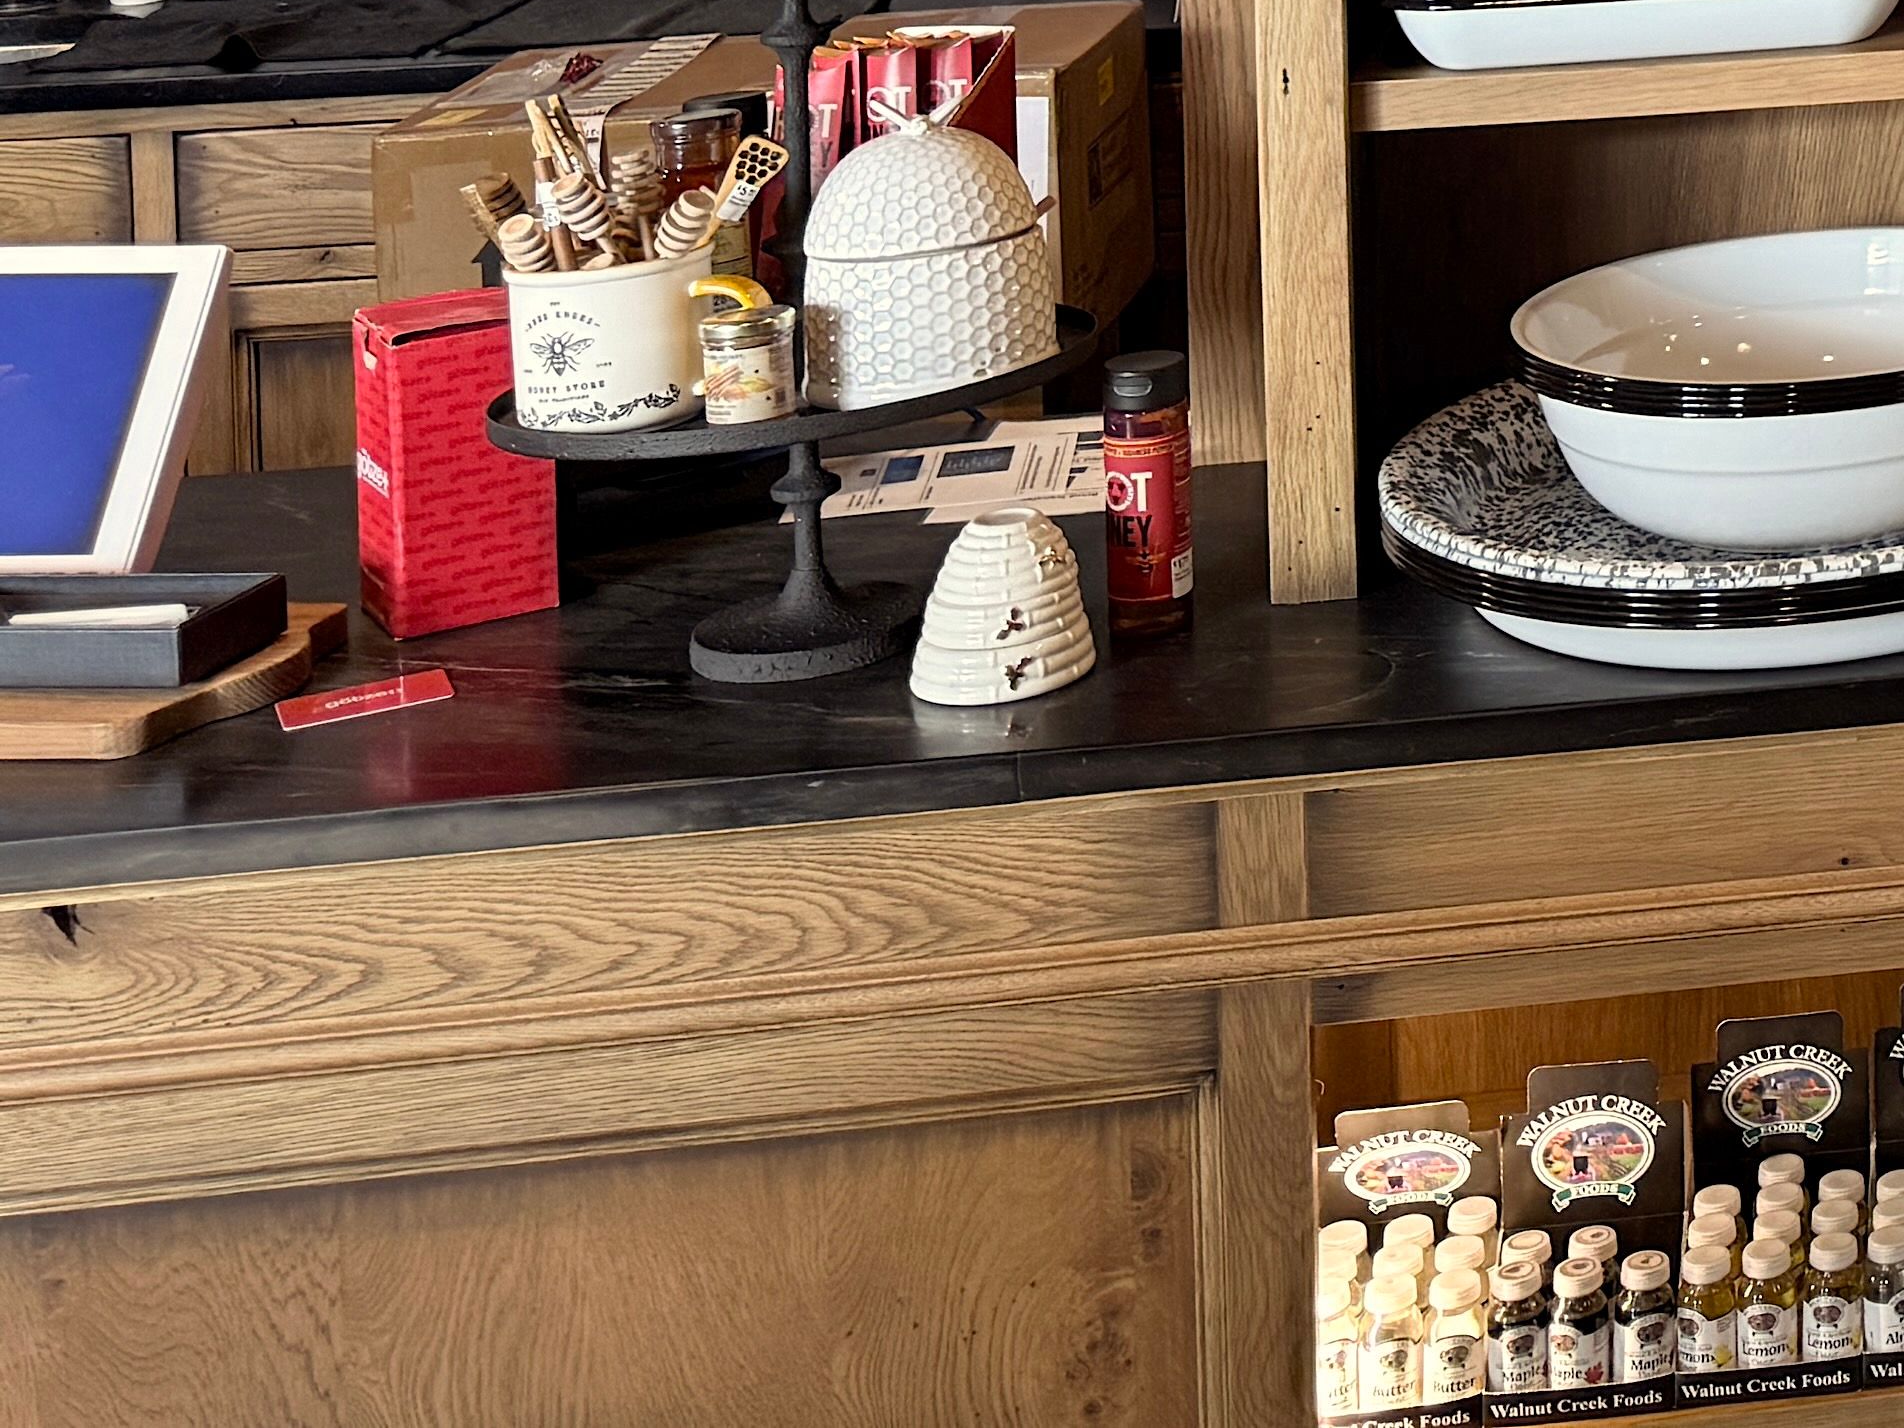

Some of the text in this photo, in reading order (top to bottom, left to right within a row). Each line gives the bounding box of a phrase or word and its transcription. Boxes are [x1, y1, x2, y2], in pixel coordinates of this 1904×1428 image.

[1707, 1044, 1853, 1092] WALNUT CREEK
[1516, 1094, 1667, 1147] WALNUT CREEK
[1760, 1122, 1807, 1134] FOODS
[1328, 1129, 1483, 1174] WALNUT CREEK
[1571, 1183, 1620, 1195] FOODS
[1742, 1344, 1786, 1357] Lemon
[1807, 1334, 1852, 1350] Lemon
[1681, 1371, 1851, 1400] Walnut Creek Foods
[1491, 1390, 1663, 1420] Walnut Creek Foods
